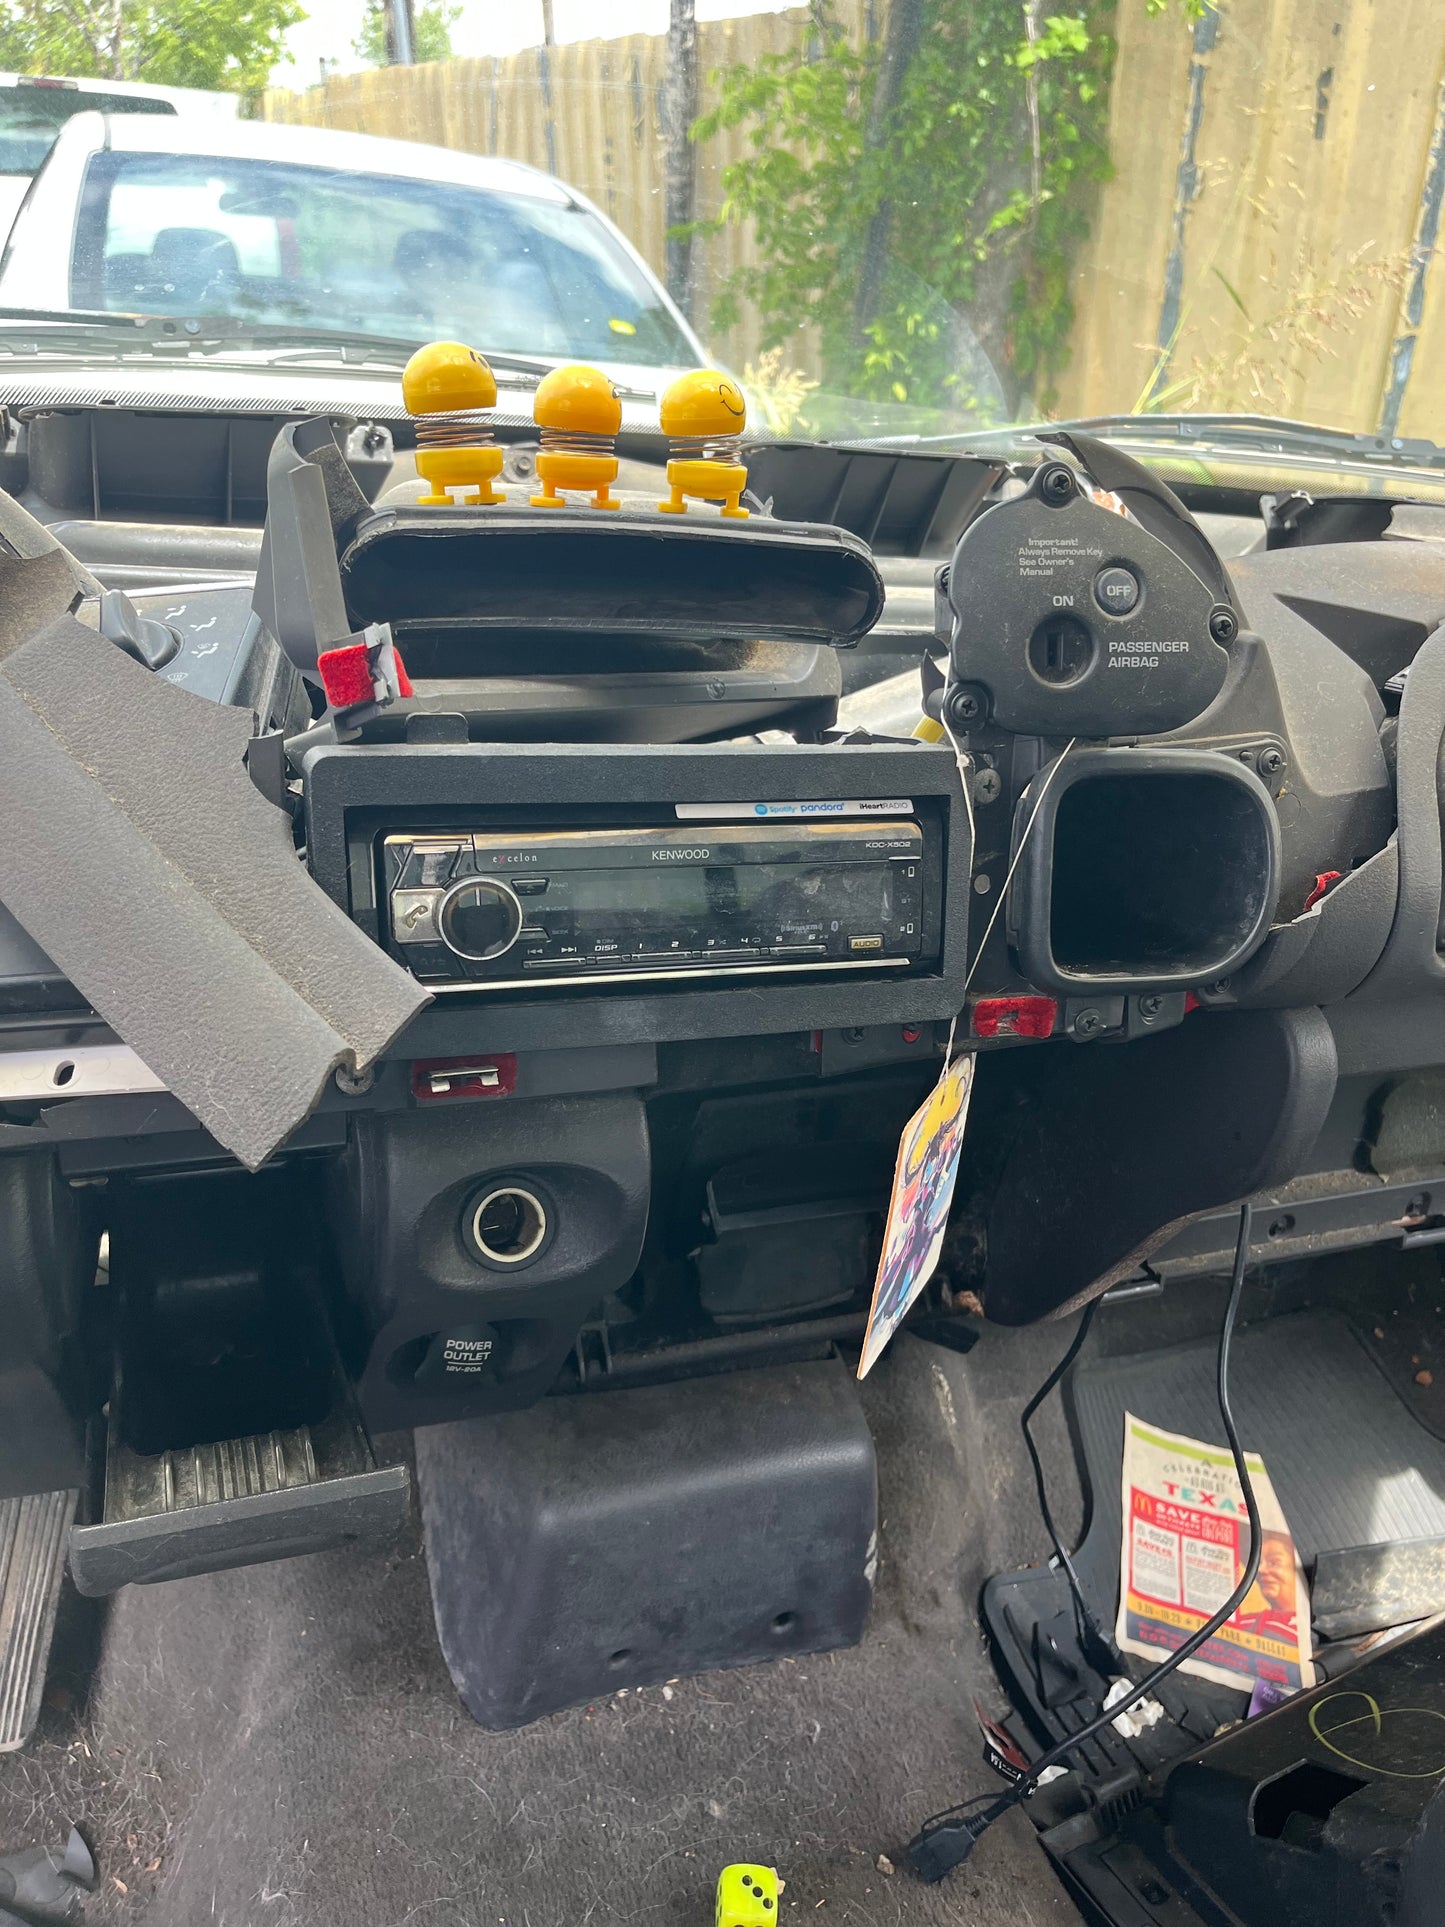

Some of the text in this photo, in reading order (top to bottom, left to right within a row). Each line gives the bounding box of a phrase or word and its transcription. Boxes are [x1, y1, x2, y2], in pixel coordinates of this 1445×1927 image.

[1028, 538, 1079, 547] Important!
[1018, 548, 1103, 558] Always Remove Key
[1019, 558, 1075, 566] See Owner's
[1019, 567, 1054, 576] Manual
[1106, 585, 1132, 597] OFF
[1052, 595, 1074, 607] ON
[1108, 641, 1190, 653] PASSENGER
[1107, 656, 1159, 668] AIRBAG
[769, 801, 908, 814] Spotify pandora iHeartRADIO
[492, 853, 538, 864] excelon
[651, 848, 710, 861] KENWOOD
[594, 944, 618, 952] DISP
[671, 940, 679, 948] 2
[852, 939, 880, 947] AUDIO
[446, 1339, 492, 1351] POWER
[443, 1350, 491, 1361] OUTLET
[1163, 1463, 1242, 1490] CELEBRATIO
[1155, 1502, 1201, 1523] SAVE
